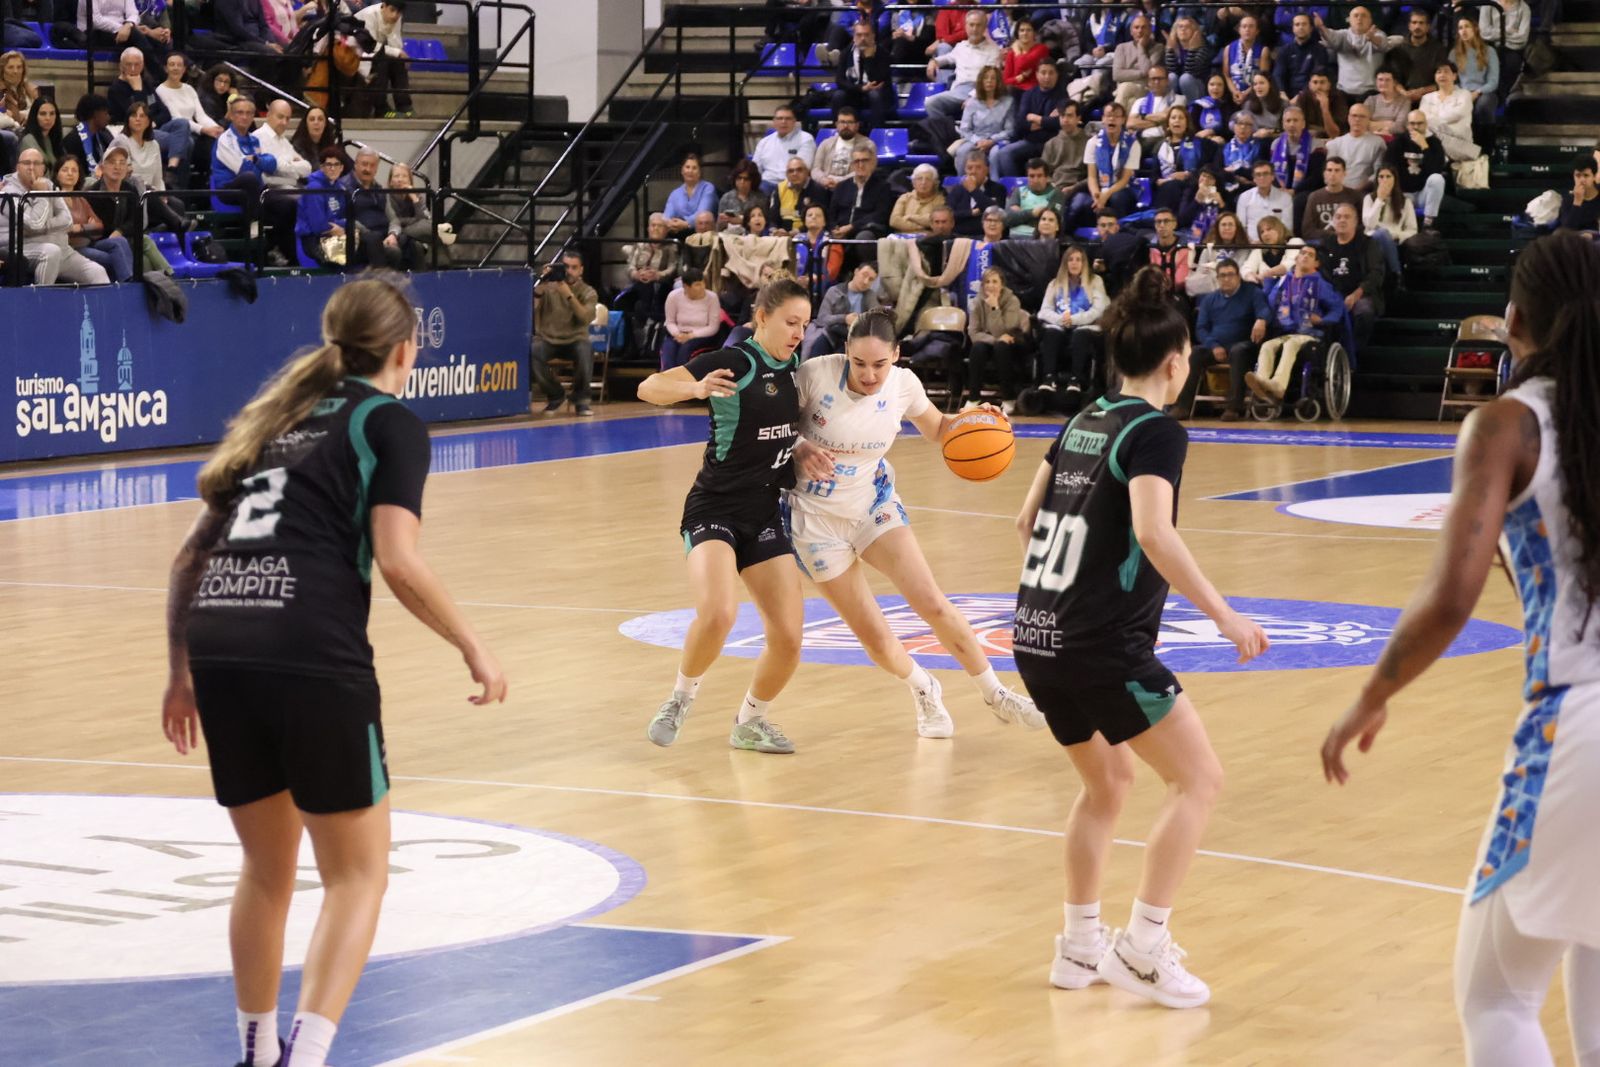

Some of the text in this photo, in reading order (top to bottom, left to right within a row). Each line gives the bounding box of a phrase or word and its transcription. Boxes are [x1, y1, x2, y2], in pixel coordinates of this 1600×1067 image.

[16, 373, 64, 397] turismo
[395, 354, 518, 400] avenida.com
[757, 423, 792, 440] SGM
[860, 441, 887, 450] LEÓN
[228, 467, 288, 540] 2
[1020, 508, 1089, 592] 20
[199, 575, 297, 598] COMPITE
[1013, 624, 1064, 648] OMPITE
